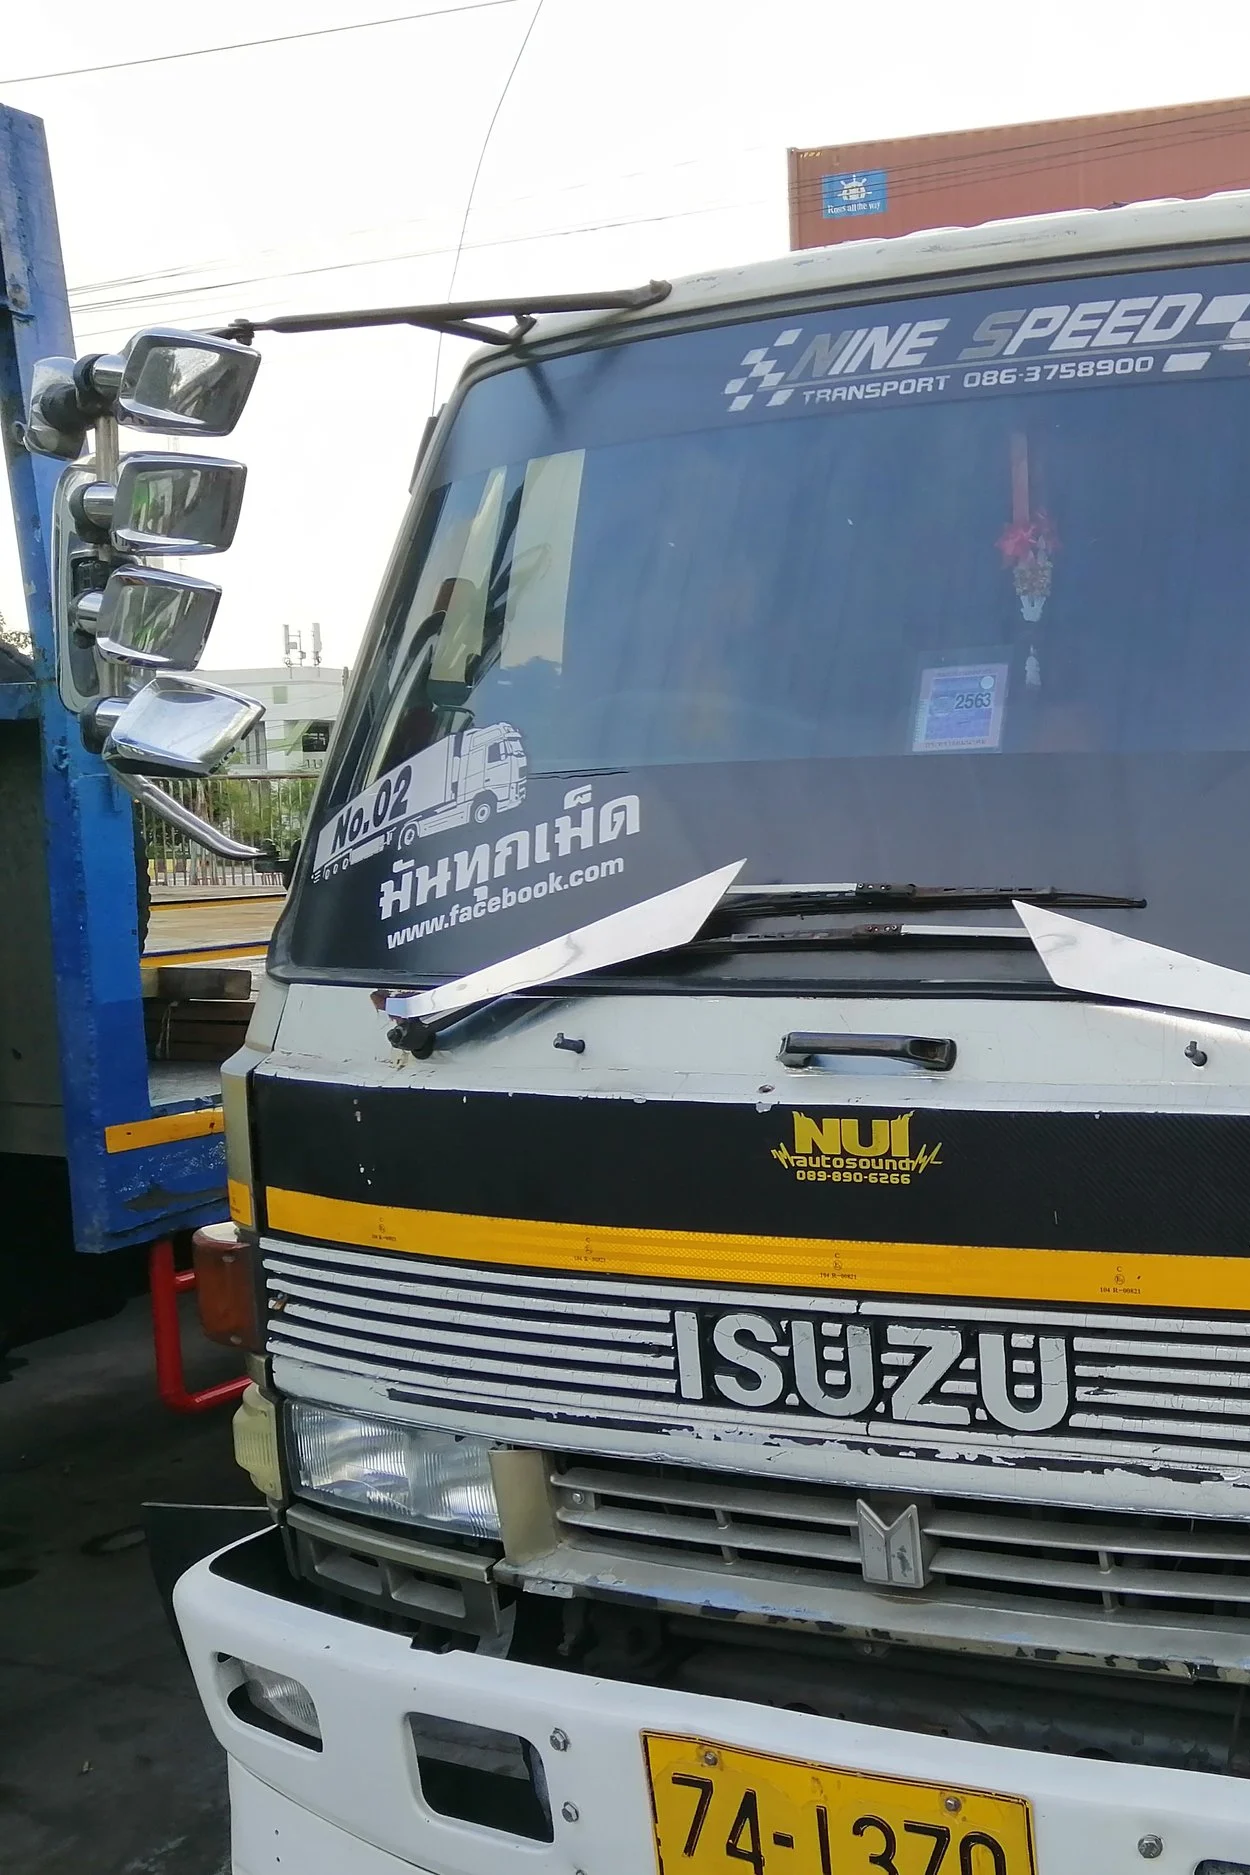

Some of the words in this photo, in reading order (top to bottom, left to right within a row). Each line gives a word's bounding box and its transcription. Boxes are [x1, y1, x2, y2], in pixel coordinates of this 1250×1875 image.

[784, 318, 951, 382] NINE
[956, 292, 1203, 361] SPEED
[803, 375, 950, 405] TRANSPORT
[963, 356, 1154, 388] 086-3758900
[955, 692, 992, 710] 2563
[331, 764, 412, 854] No.02
[379, 783, 641, 921] มันทุกเม็ด
[387, 856, 625, 950] www.facebook.com
[791, 1110, 915, 1158] NUI
[795, 1155, 914, 1172] autosound
[795, 1169, 911, 1186] 089-890-6266
[674, 1310, 1070, 1431] ISUZU
